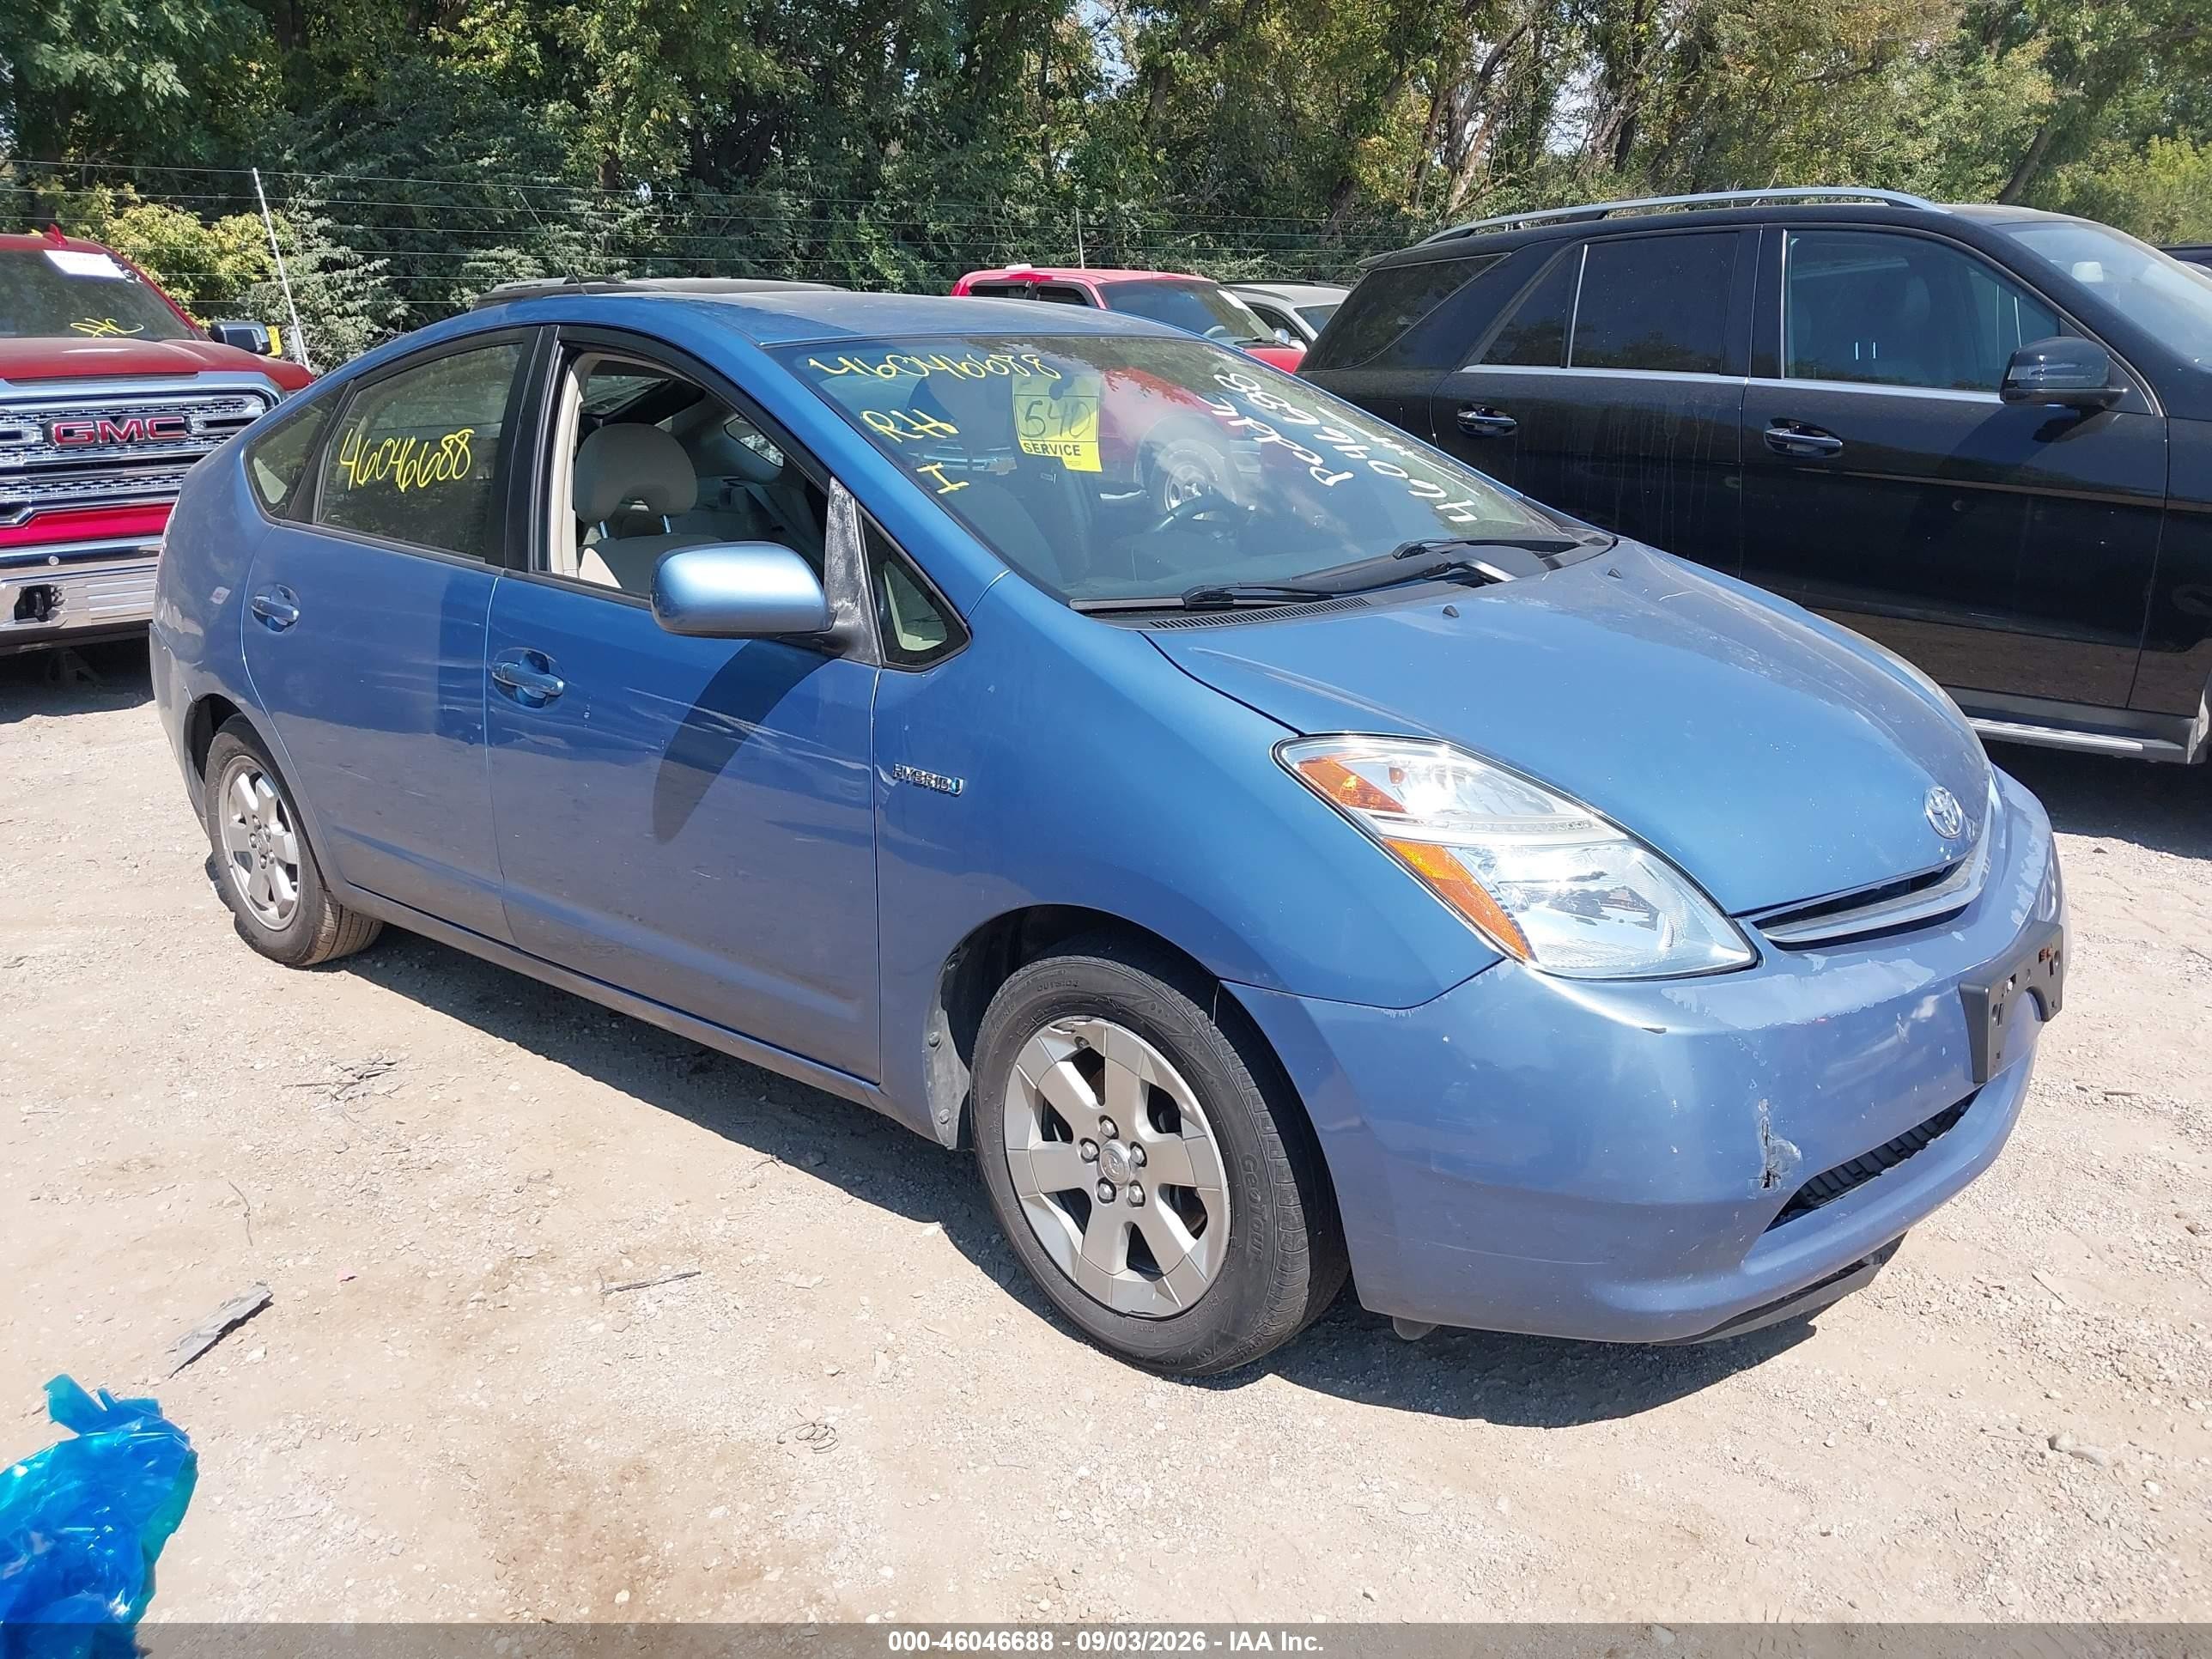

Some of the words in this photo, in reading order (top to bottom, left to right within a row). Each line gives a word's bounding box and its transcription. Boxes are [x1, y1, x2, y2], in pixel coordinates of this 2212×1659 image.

[808, 353, 1062, 380] 46046688
[53, 416, 188, 446] GMC
[860, 409, 959, 443] RH
[1020, 399, 1091, 439] 540
[338, 428, 474, 493] 46046688
[1023, 442, 1082, 457] SERVICE
[1213, 373, 1478, 523] 46046688
[892, 763, 950, 791] HYBRID
[1241, 1152, 1267, 1266] GeoTour
